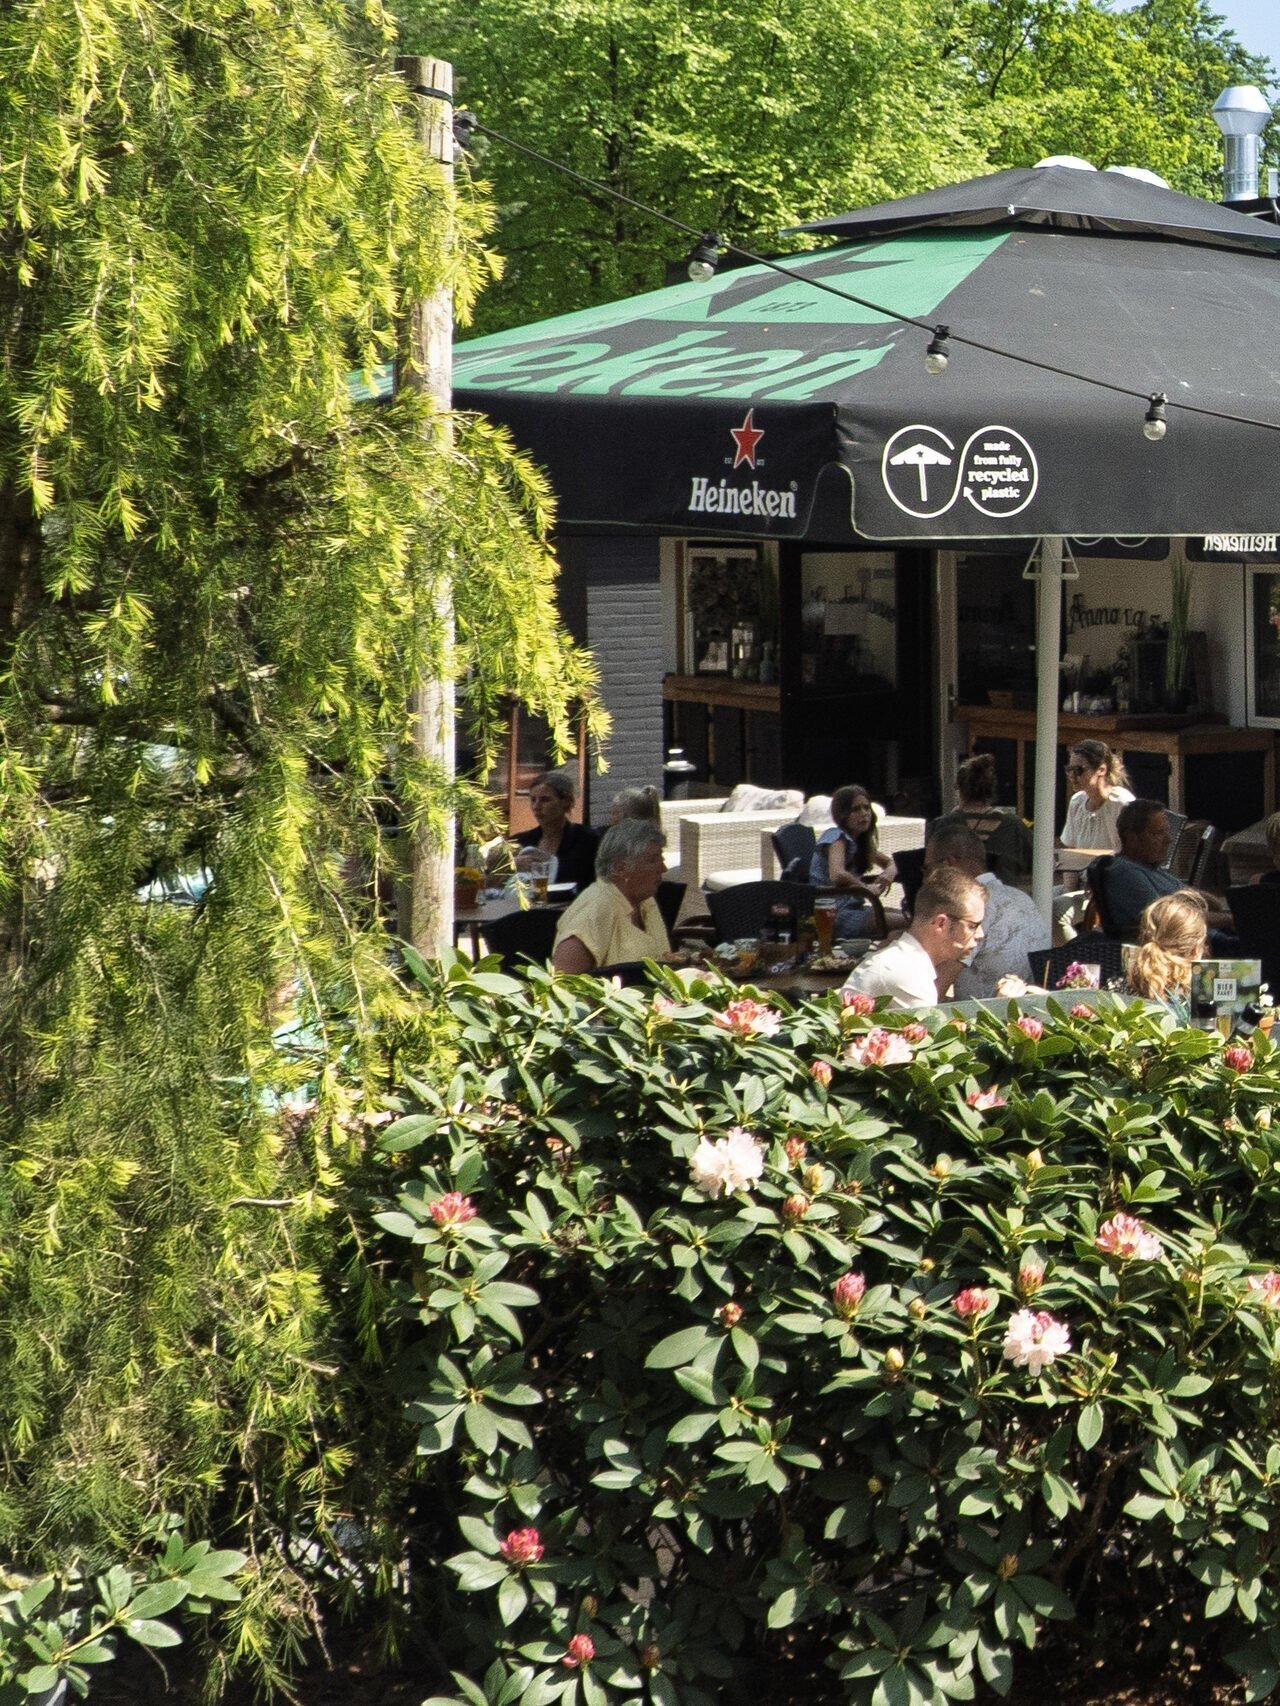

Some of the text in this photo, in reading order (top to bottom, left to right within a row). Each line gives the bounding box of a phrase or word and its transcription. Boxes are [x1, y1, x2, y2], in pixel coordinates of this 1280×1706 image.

[453, 330, 896, 400] eken
[983, 441, 1011, 451] made
[973, 454, 1022, 468] from fully
[968, 468, 1030, 485] recycled
[688, 477, 797, 518] Heineken
[981, 486, 1021, 501] plastic
